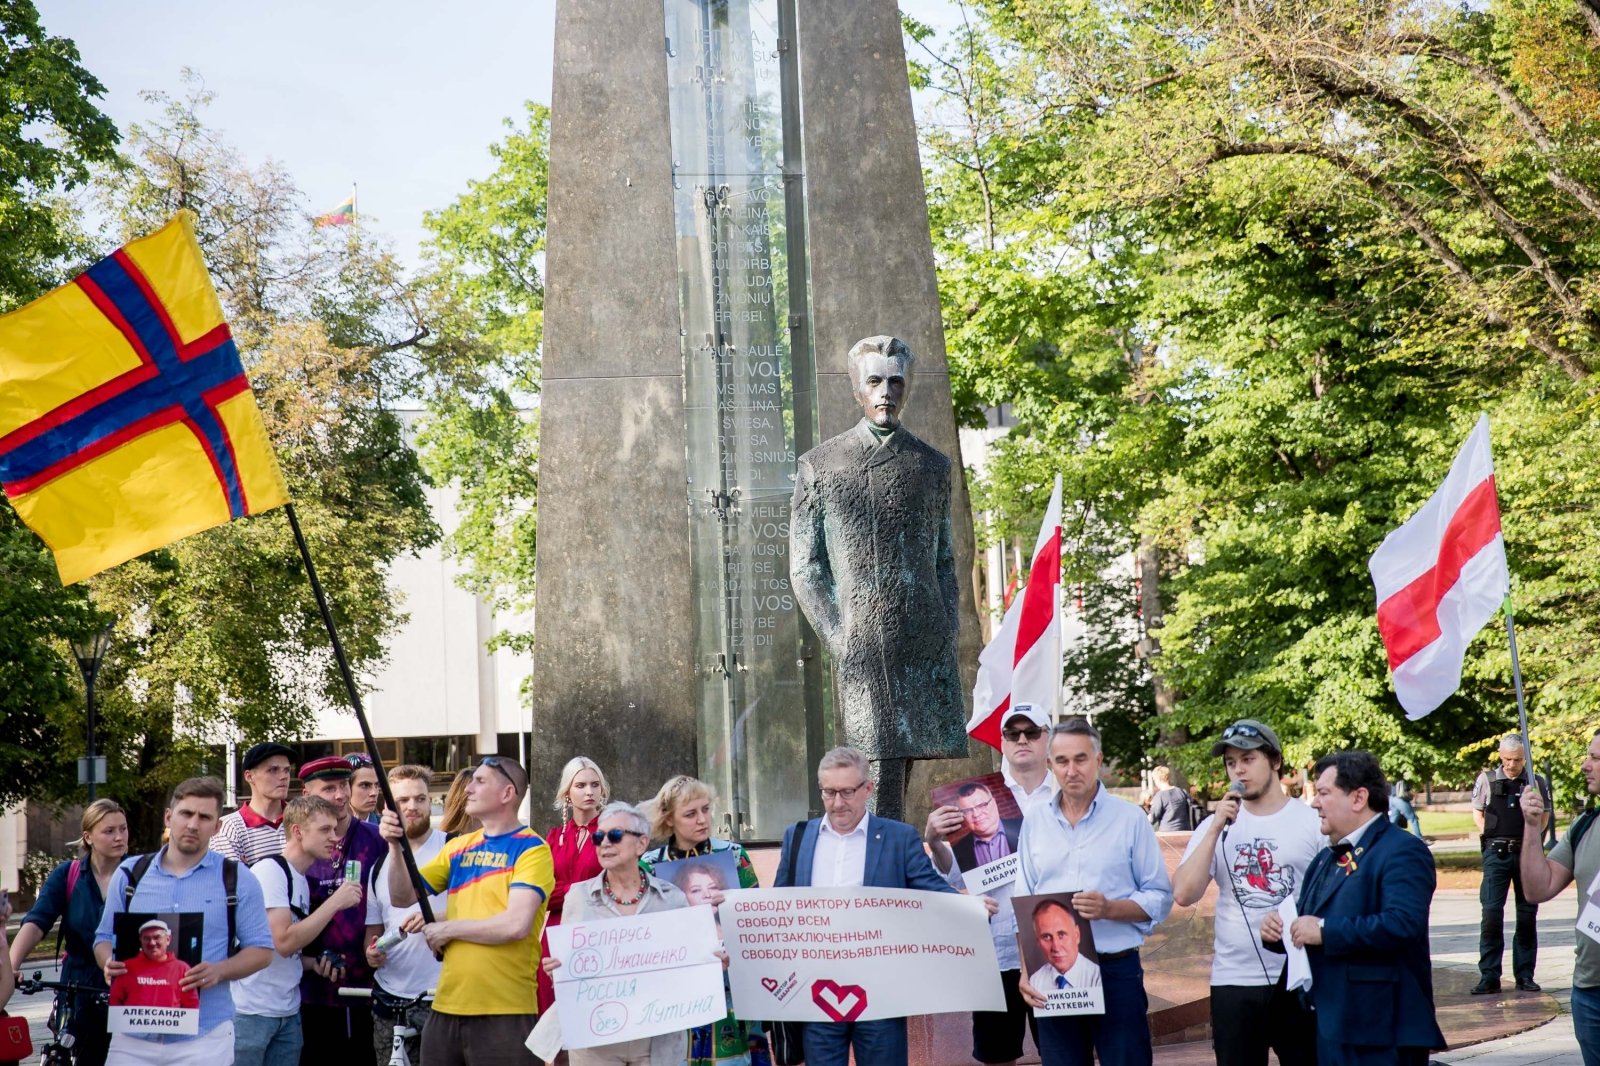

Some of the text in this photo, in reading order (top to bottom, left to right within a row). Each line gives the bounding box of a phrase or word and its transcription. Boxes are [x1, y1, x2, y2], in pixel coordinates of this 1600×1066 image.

[712, 308, 767, 322] ĖRYBEI.
[760, 578, 789, 590] TOS
[460, 850, 509, 868] INGRIA
[984, 857, 1017, 875] ВИКТОР
[981, 866, 1018, 886] БАБАРИ
[734, 898, 923, 913] СВОБОДУ ВИКТОРУ БАБАРИКО!
[736, 915, 831, 929] СВОБОДУ ВСЕМ
[739, 929, 882, 944] ПОЛИТЗАКЛЮЧЕННЫМ!
[573, 946, 688, 974] без Лукашенко
[741, 948, 798, 961] СВОБОДУ
[921, 944, 975, 957] НАРОДА!
[576, 977, 638, 1003] Россия
[1047, 988, 1089, 1000] НИКОЛАЙ
[122, 1008, 187, 1018] АЛЕКСАНДР
[1044, 1001, 1095, 1011] СТАТКЕВИЧ
[129, 1018, 179, 1027] КАБАНОВ
